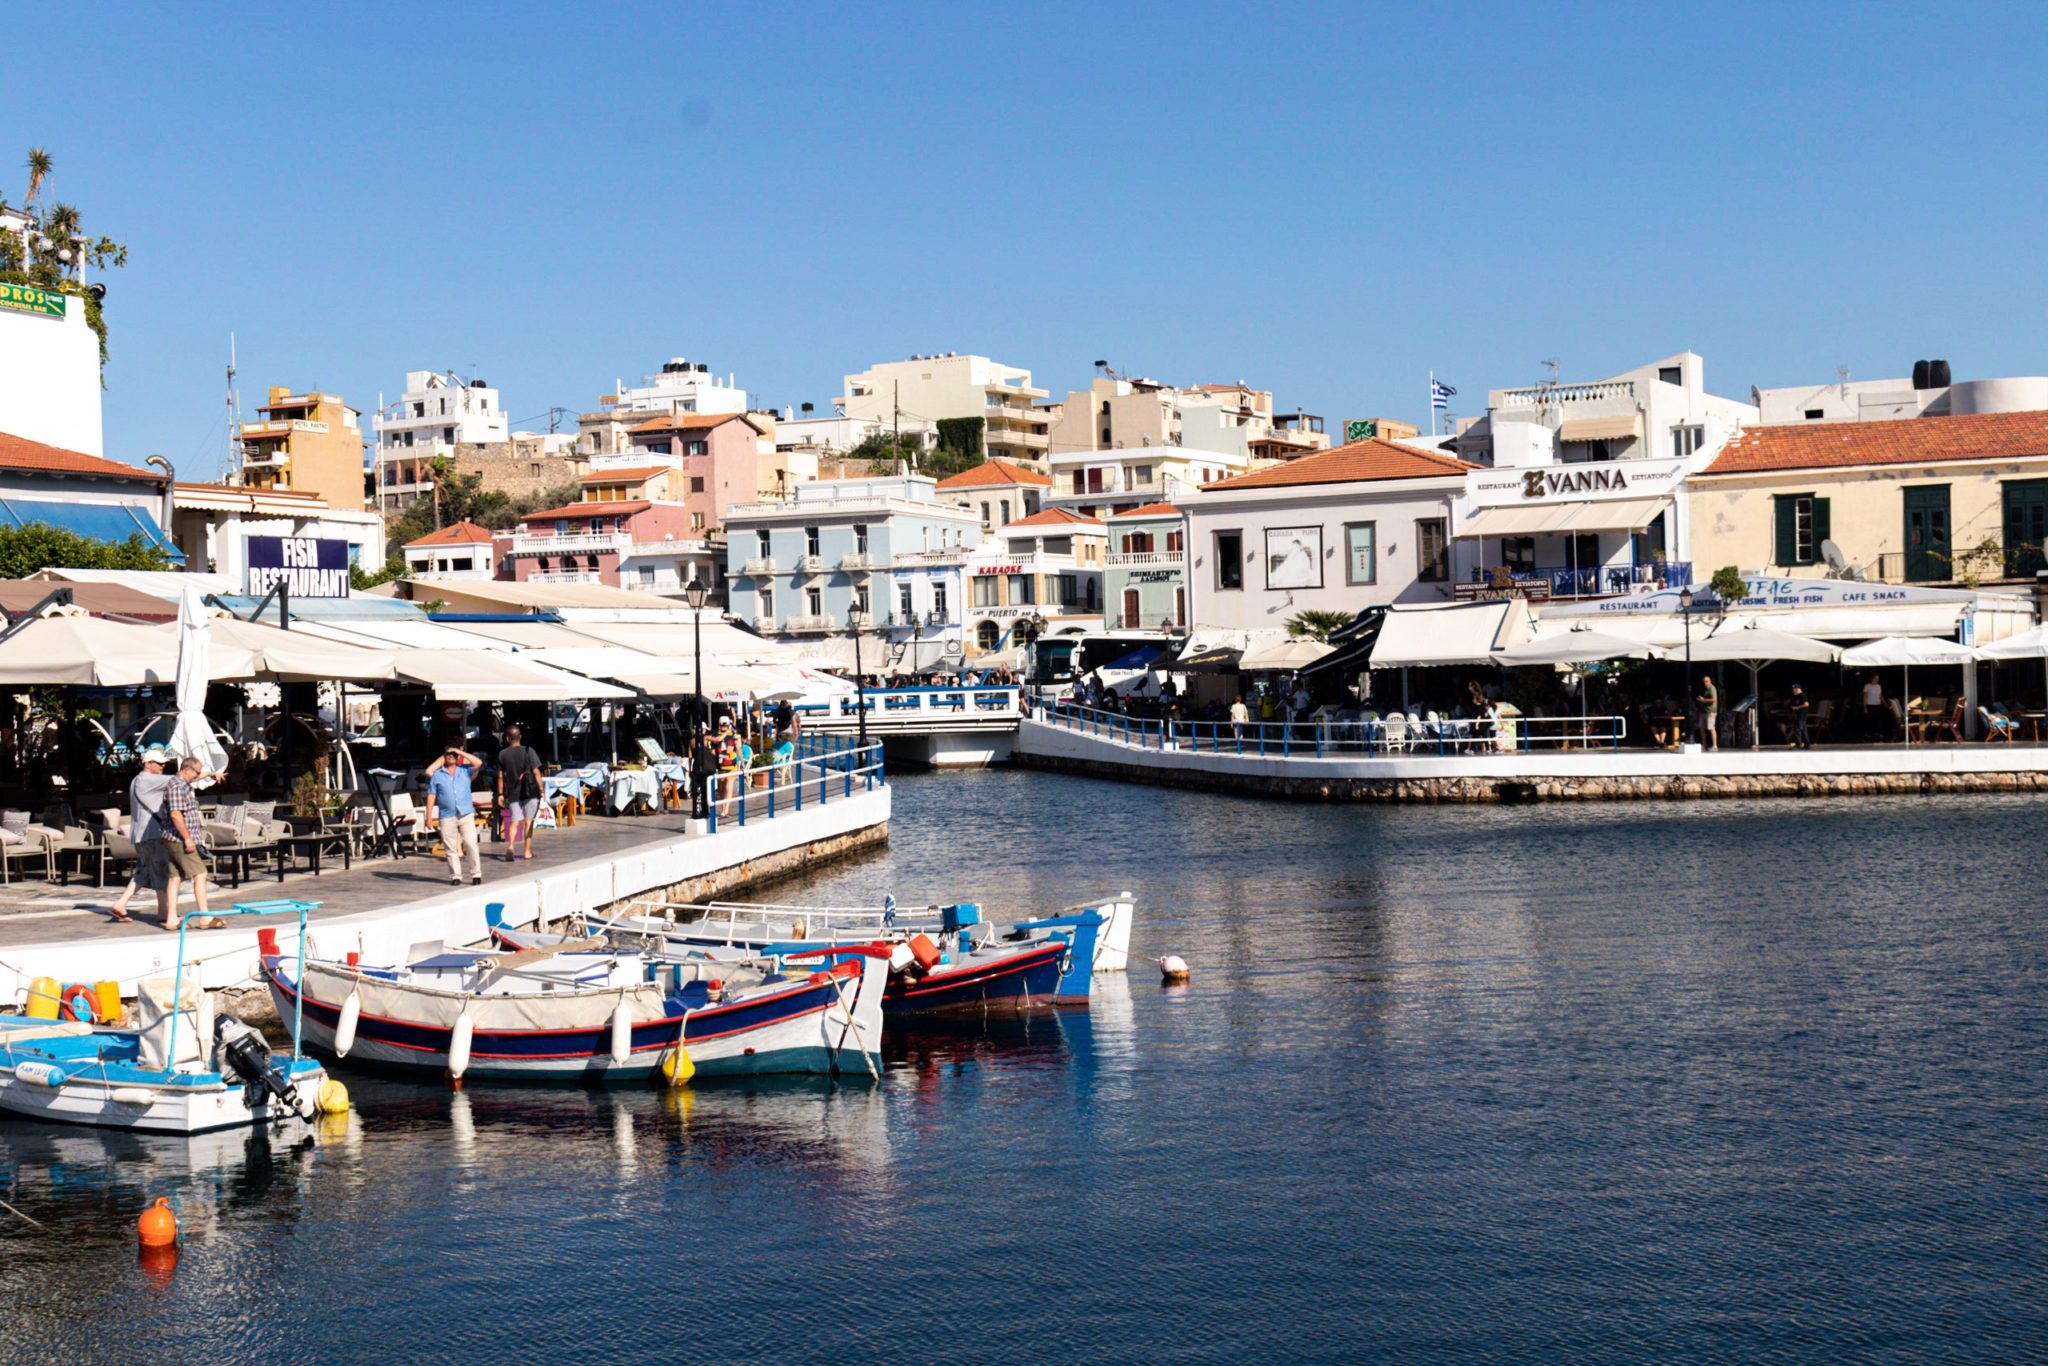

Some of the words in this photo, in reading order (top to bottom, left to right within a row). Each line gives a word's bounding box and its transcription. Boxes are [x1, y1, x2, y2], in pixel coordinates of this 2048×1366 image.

[1477, 481, 1521, 490] RESTAURANT
[281, 538, 318, 567] FISH
[978, 565, 1022, 575] KARAOKE
[249, 567, 348, 597] RESTAURANT
[1599, 601, 1659, 611] RESTAURANT
[1773, 596, 1799, 605] FRESH
[1804, 595, 1823, 604] FISH
[1842, 593, 1866, 602] CAFE
[1872, 591, 1907, 600] SNACK
